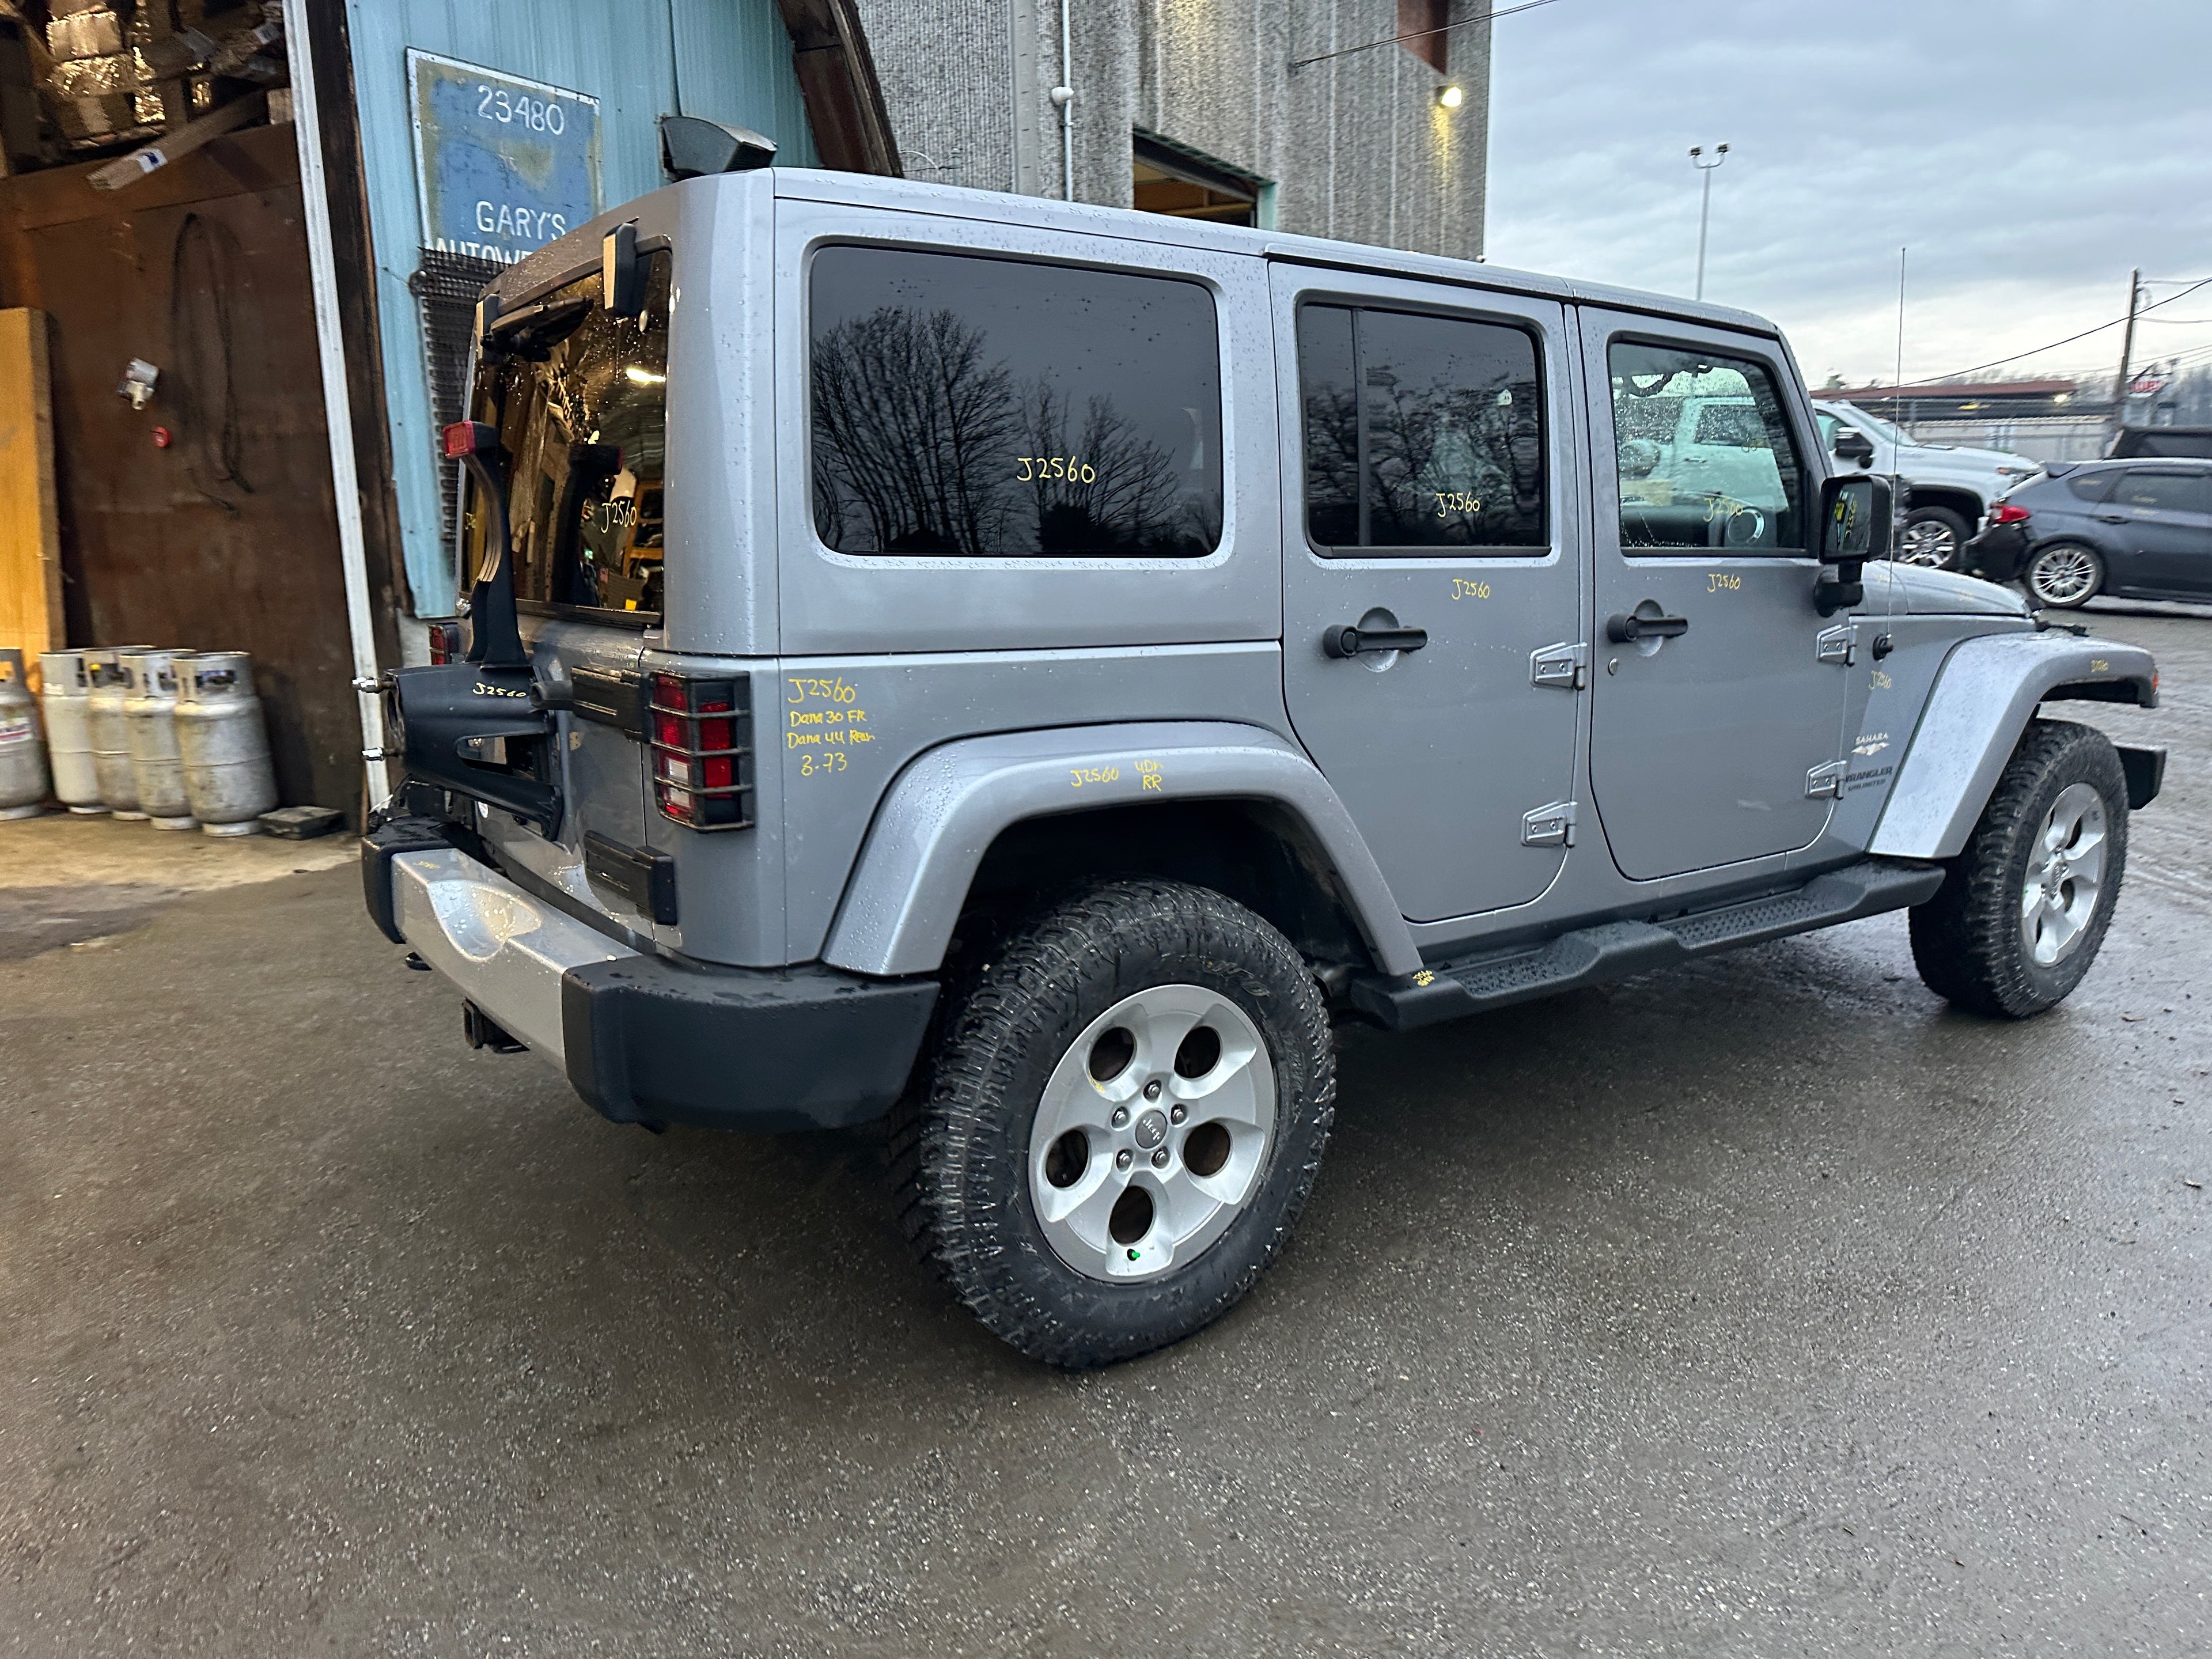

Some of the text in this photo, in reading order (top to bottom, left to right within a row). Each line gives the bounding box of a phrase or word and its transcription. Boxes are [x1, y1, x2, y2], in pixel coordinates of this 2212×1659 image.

[478, 85, 565, 135] 23480
[476, 200, 566, 241] GARY'S
[1016, 455, 1096, 484] J2560
[601, 499, 637, 533] J2560
[1435, 491, 1480, 518] J2560
[1451, 578, 1490, 600] J2560
[1707, 573, 1741, 593] J2560
[472, 681, 527, 698] J2560
[787, 676, 856, 703] J2560
[1855, 731, 1889, 745] SAHARA
[1070, 766, 1119, 787] J2560
